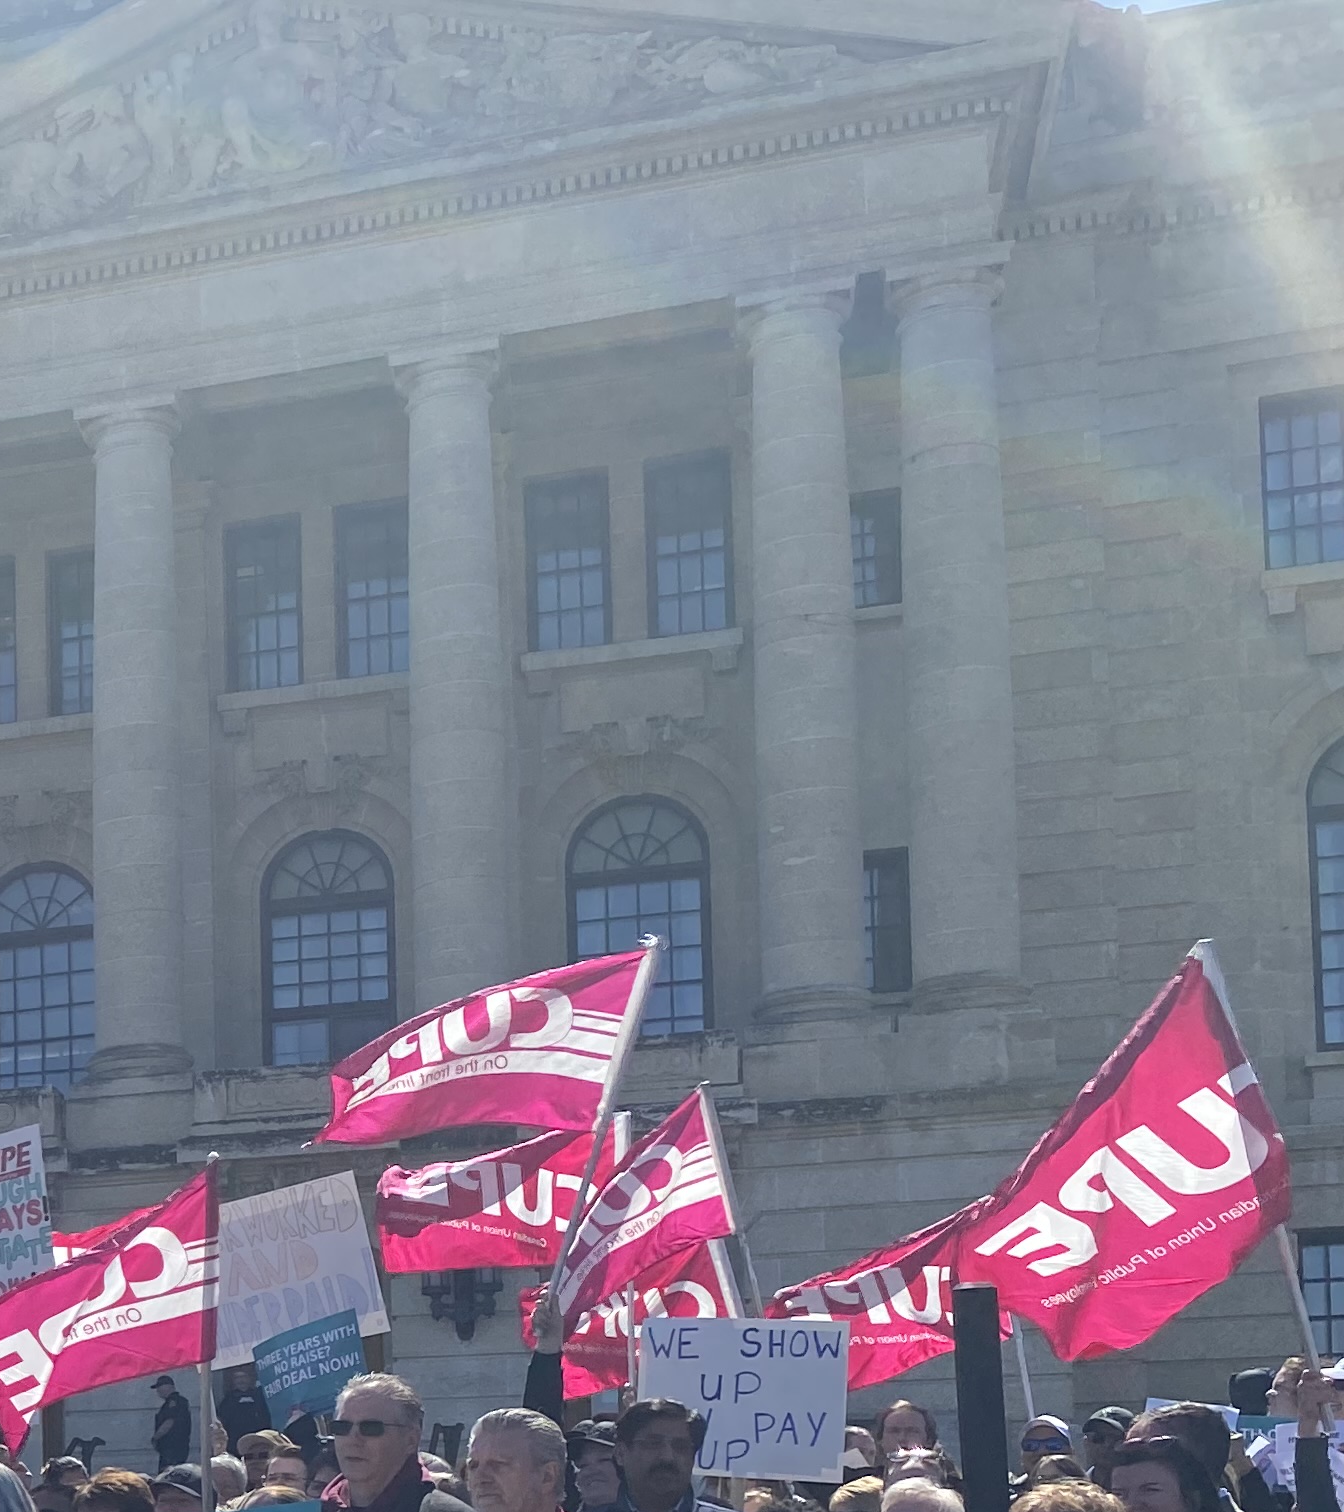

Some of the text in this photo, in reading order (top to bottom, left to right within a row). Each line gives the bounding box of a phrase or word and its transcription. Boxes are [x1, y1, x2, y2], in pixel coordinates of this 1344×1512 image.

[648, 1327, 700, 1359] WE
[740, 1327, 842, 1359] SHOW
[754, 1412, 828, 1447] PAY
[698, 1438, 751, 1472] UP
